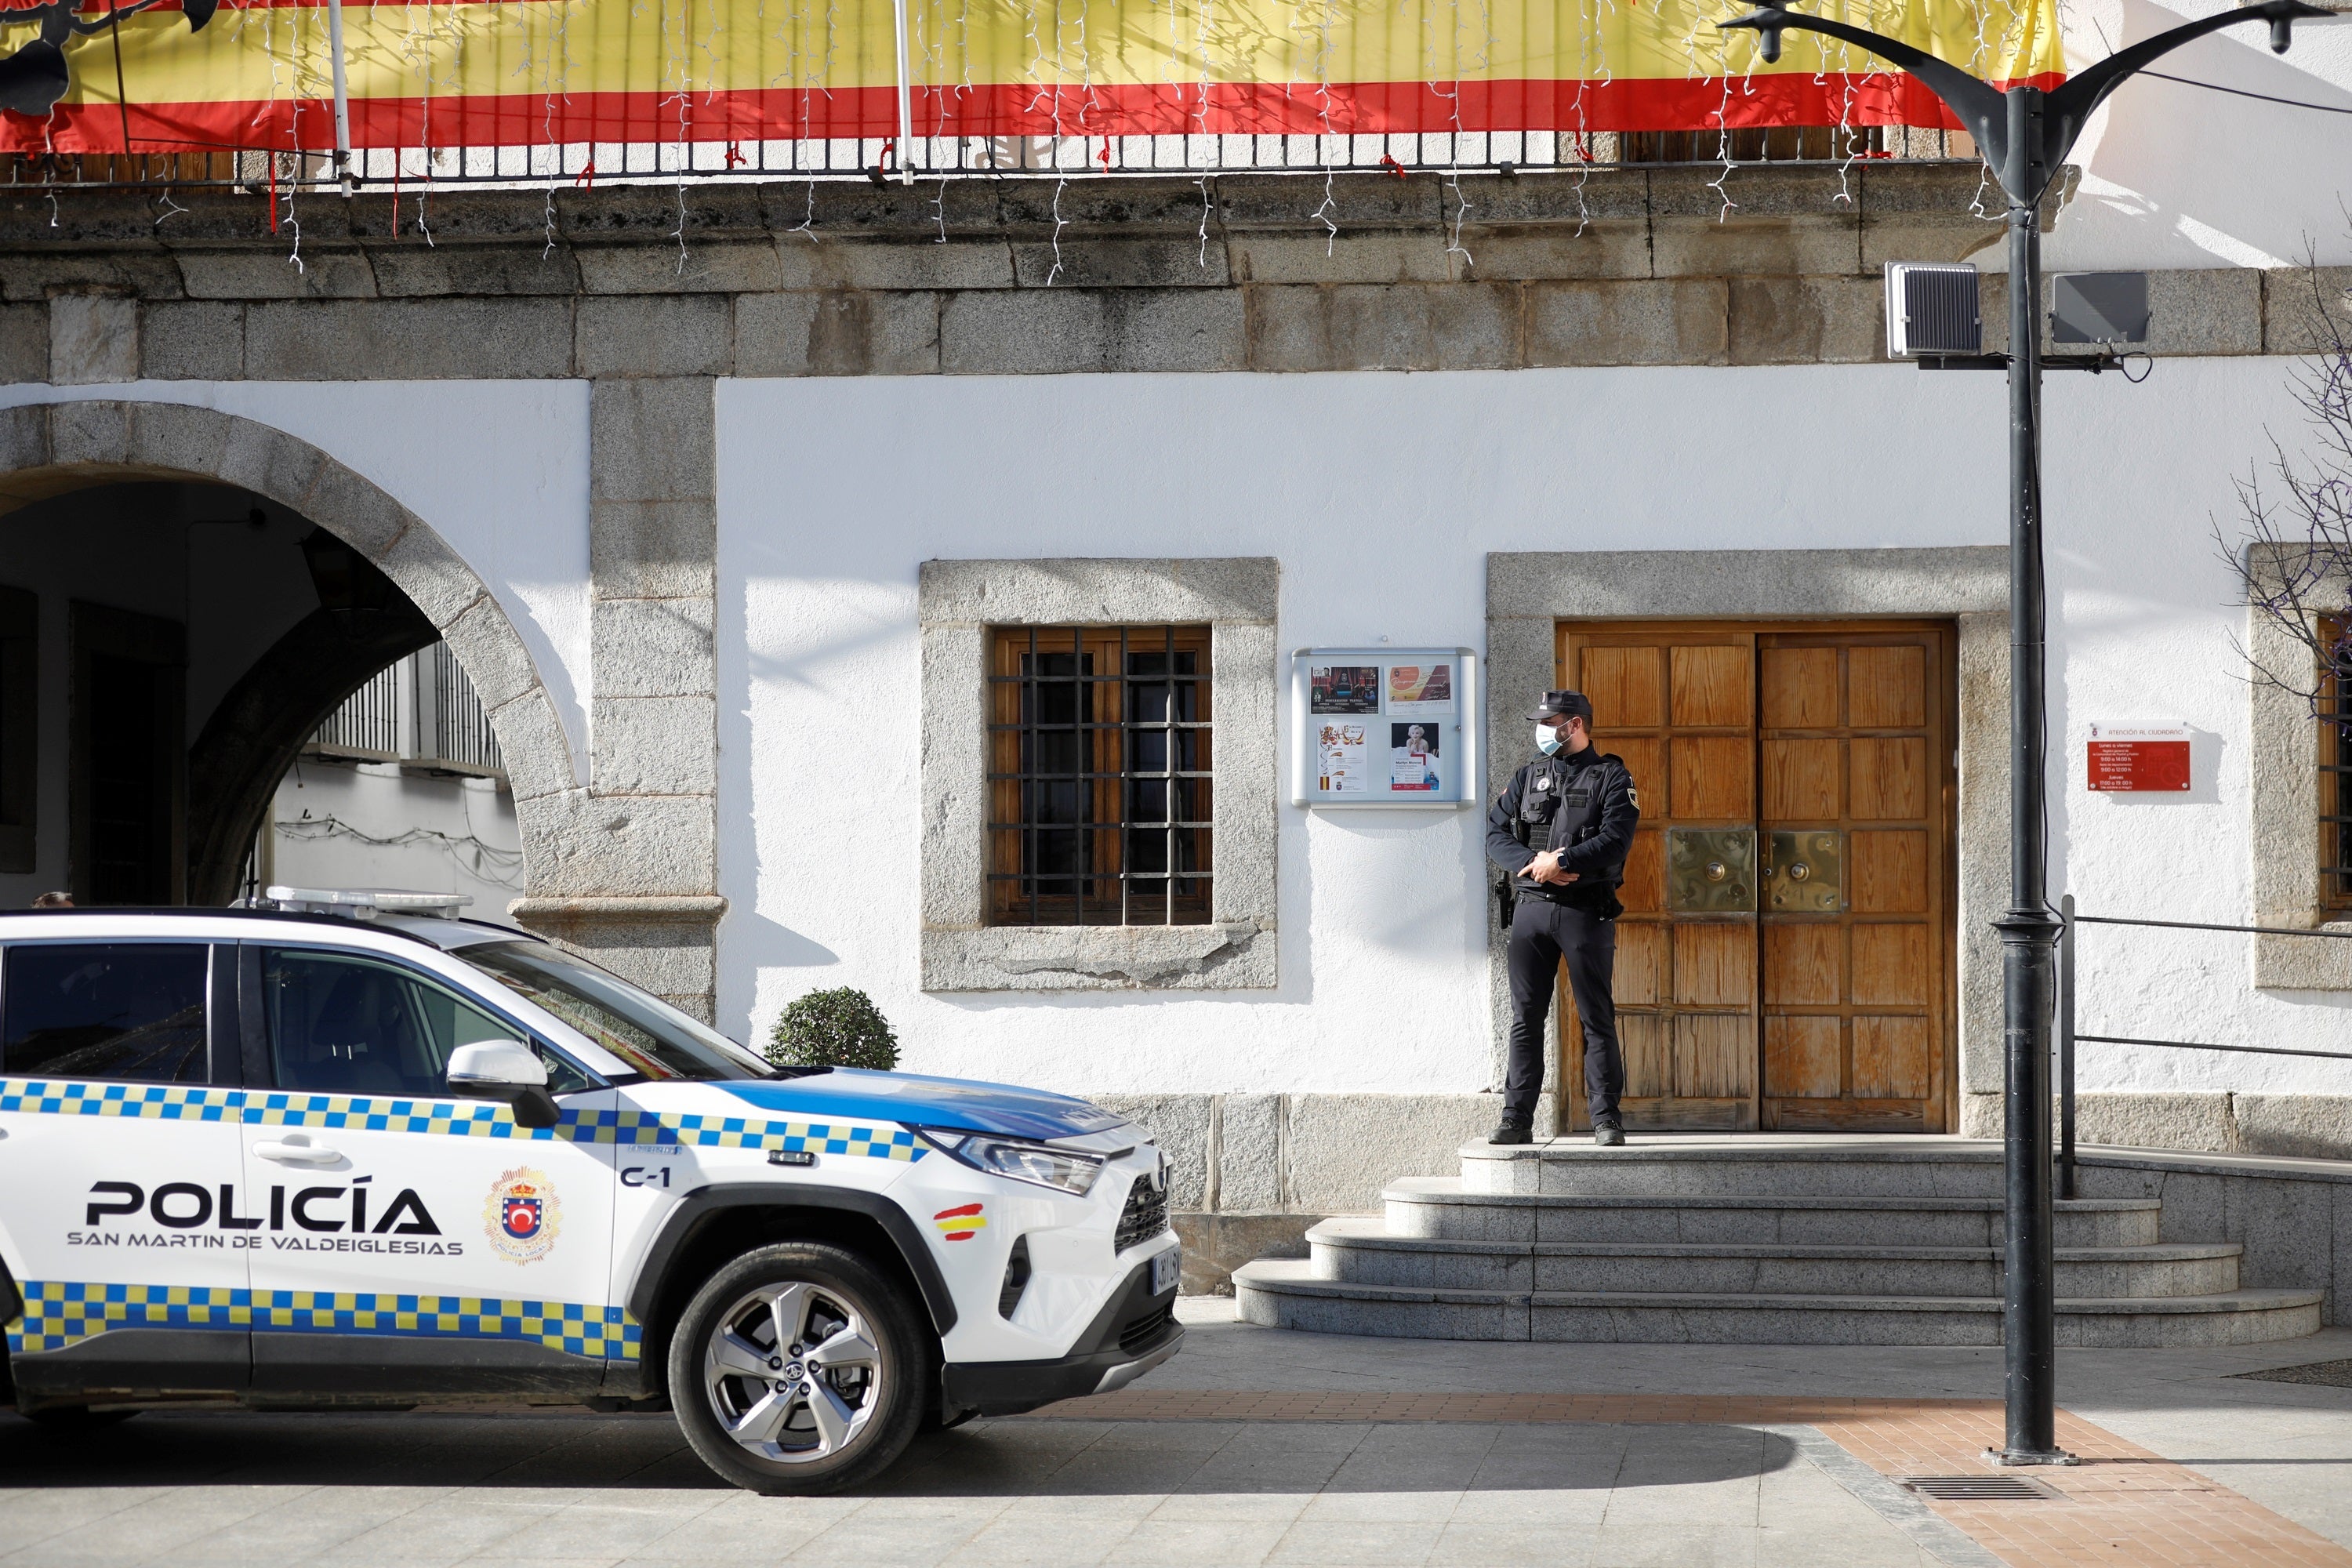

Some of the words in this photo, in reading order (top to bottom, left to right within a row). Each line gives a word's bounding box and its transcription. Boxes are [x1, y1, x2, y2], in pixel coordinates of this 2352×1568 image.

[620, 1167, 670, 1188] C-1
[85, 1175, 442, 1236] POLICÍA
[67, 1232, 119, 1246] SAN
[127, 1233, 226, 1249] MARTIN
[232, 1236, 263, 1250] DE
[270, 1236, 463, 1256] VALDEIGLESIAS
[525, 1244, 546, 1257] LOCAL
